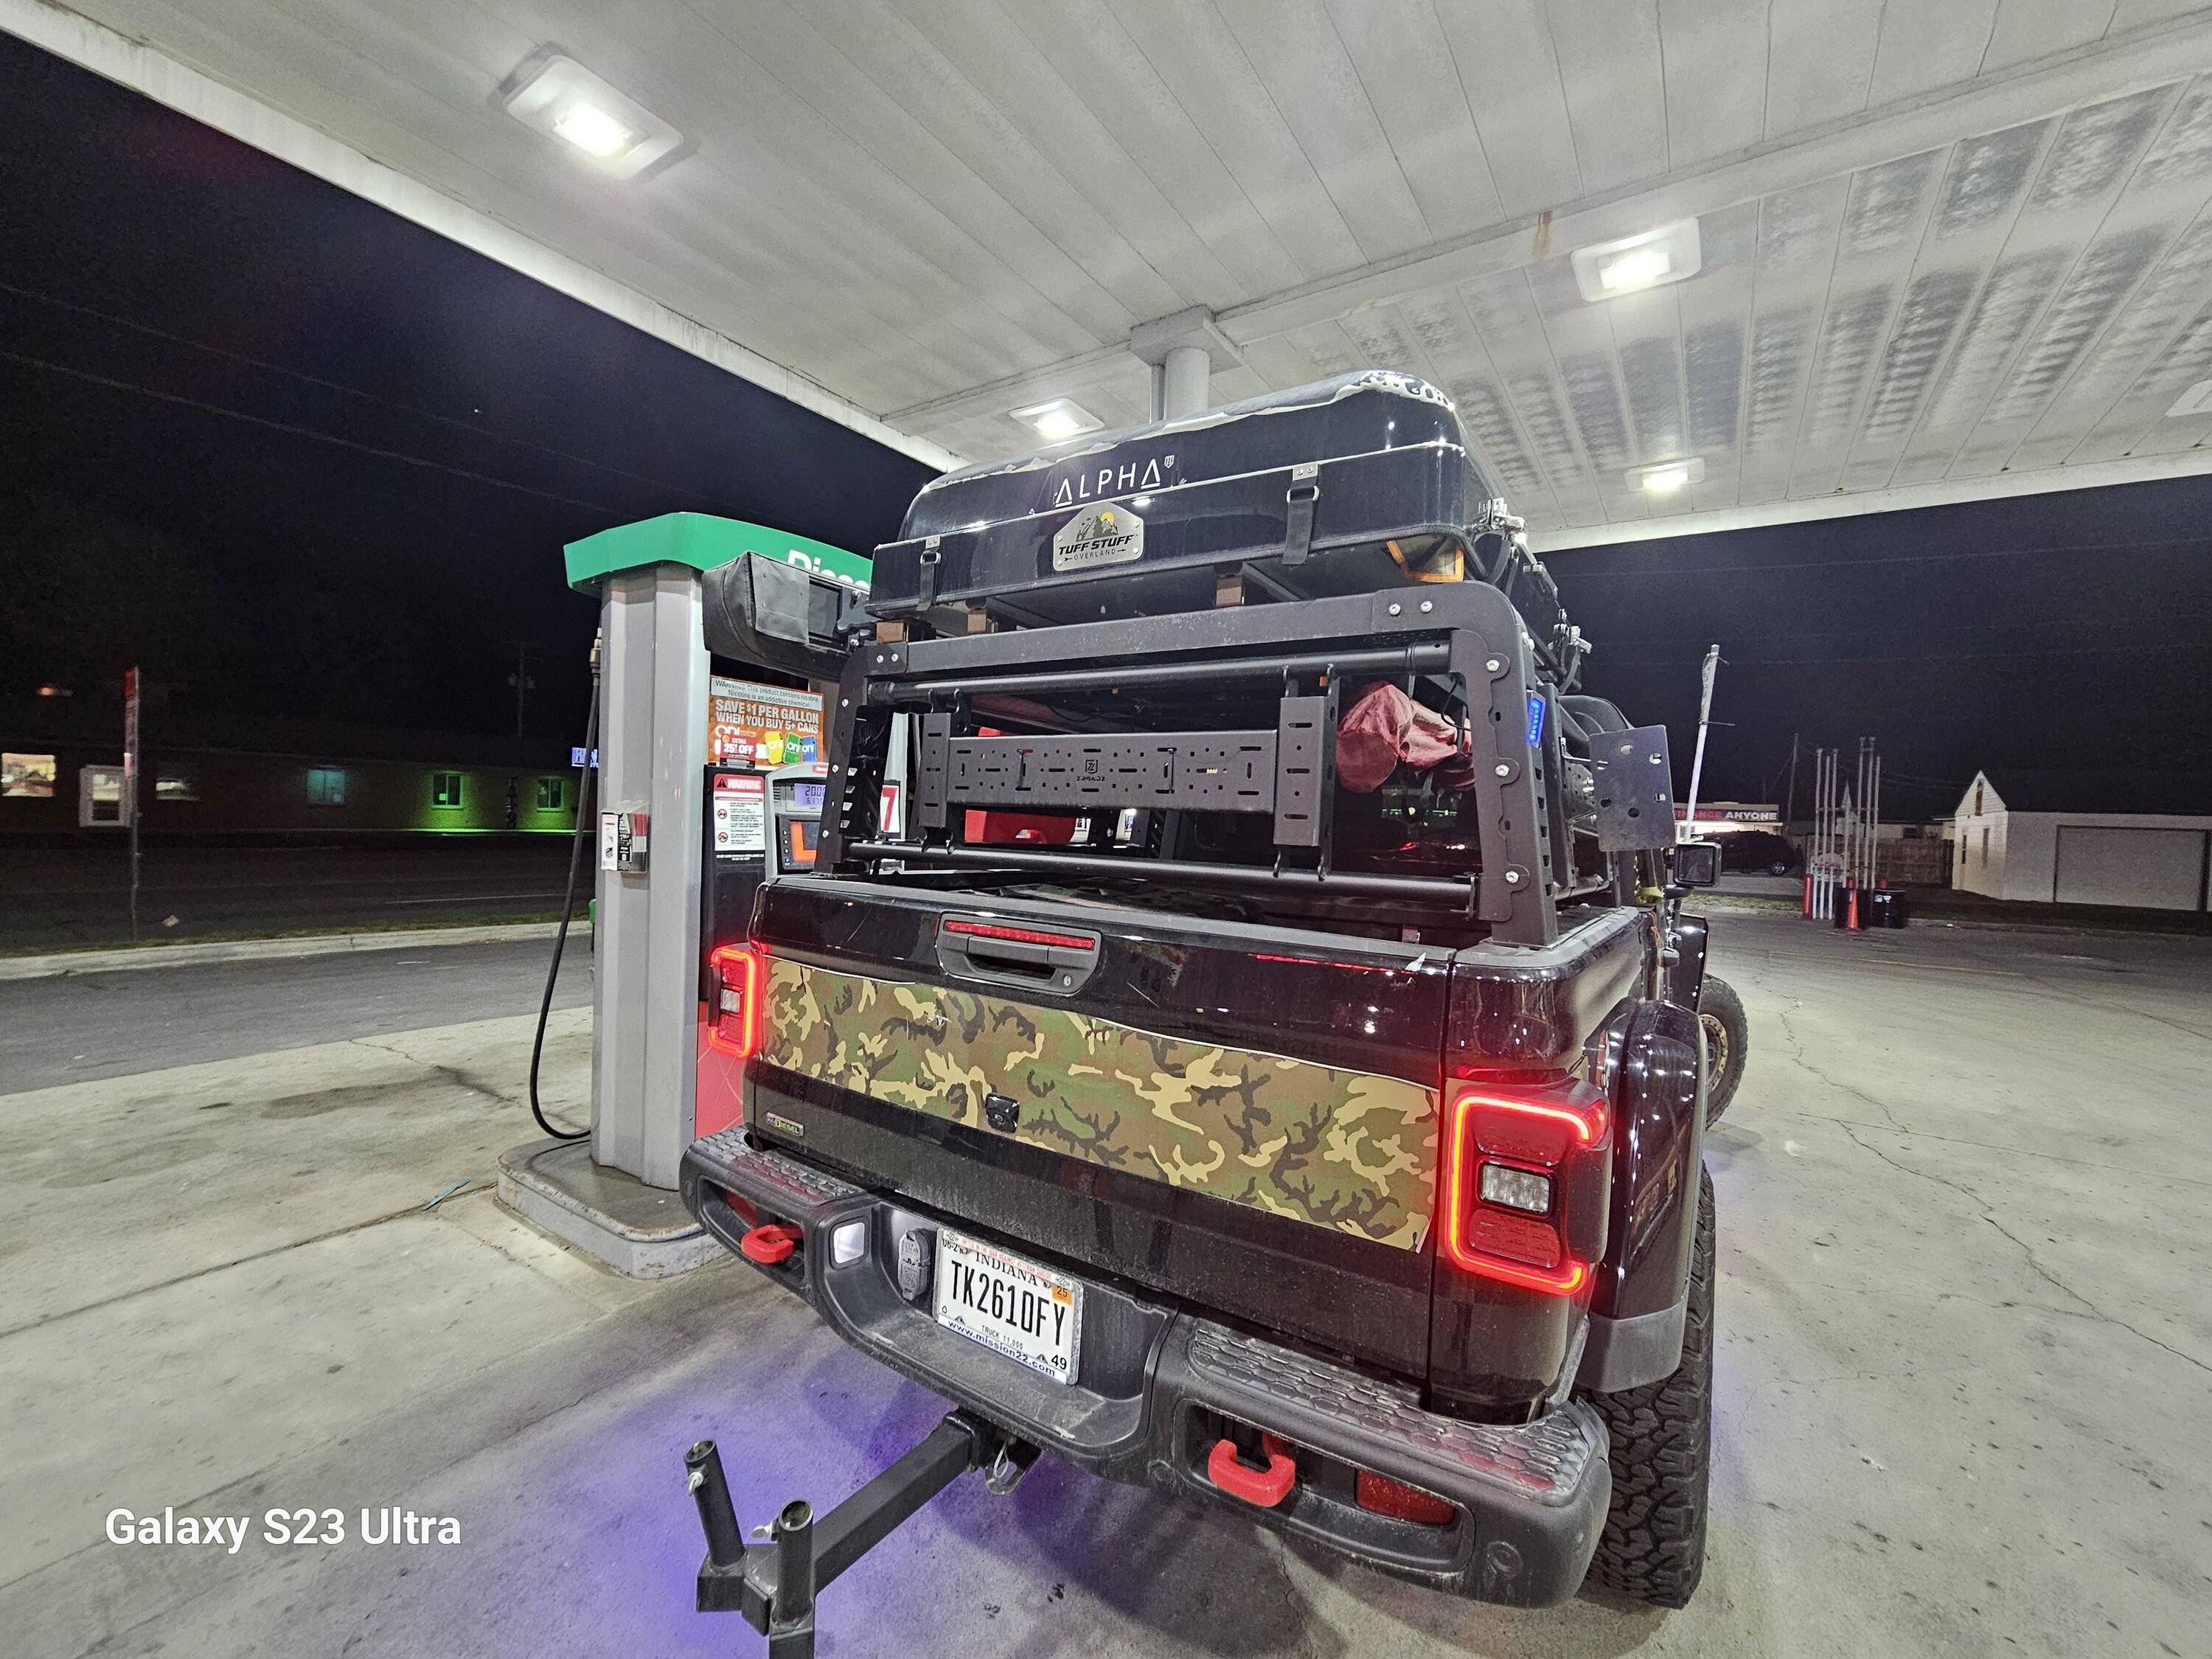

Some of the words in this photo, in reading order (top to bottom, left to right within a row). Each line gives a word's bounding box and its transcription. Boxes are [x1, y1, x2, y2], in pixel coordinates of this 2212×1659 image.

[1054, 458, 1161, 507] ALPHA
[1059, 542, 1091, 555] TUFF
[1091, 535, 1134, 549] STUFF
[1074, 549, 1116, 560] OVERLAND
[728, 690, 751, 699] Nicotine
[765, 696, 787, 705] addictive
[759, 687, 779, 696] product
[715, 699, 745, 714] SAVE
[747, 703, 757, 716] $1
[759, 705, 779, 719] PER
[781, 709, 819, 724] GALLON
[716, 712, 745, 724] WHEN
[746, 715, 764, 727] YOU
[766, 717, 784, 729] BUY
[797, 722, 819, 734] CANS
[882, 787, 898, 832] 7
[1725, 811, 1778, 821] ANYONE
[975, 1252, 1037, 1286] INDIANA
[1056, 1286, 1068, 1298] 25
[981, 1324, 999, 1338] TRUCK
[948, 1321, 1056, 1377] www.mission22.com
[1051, 1354, 1067, 1371] 49
